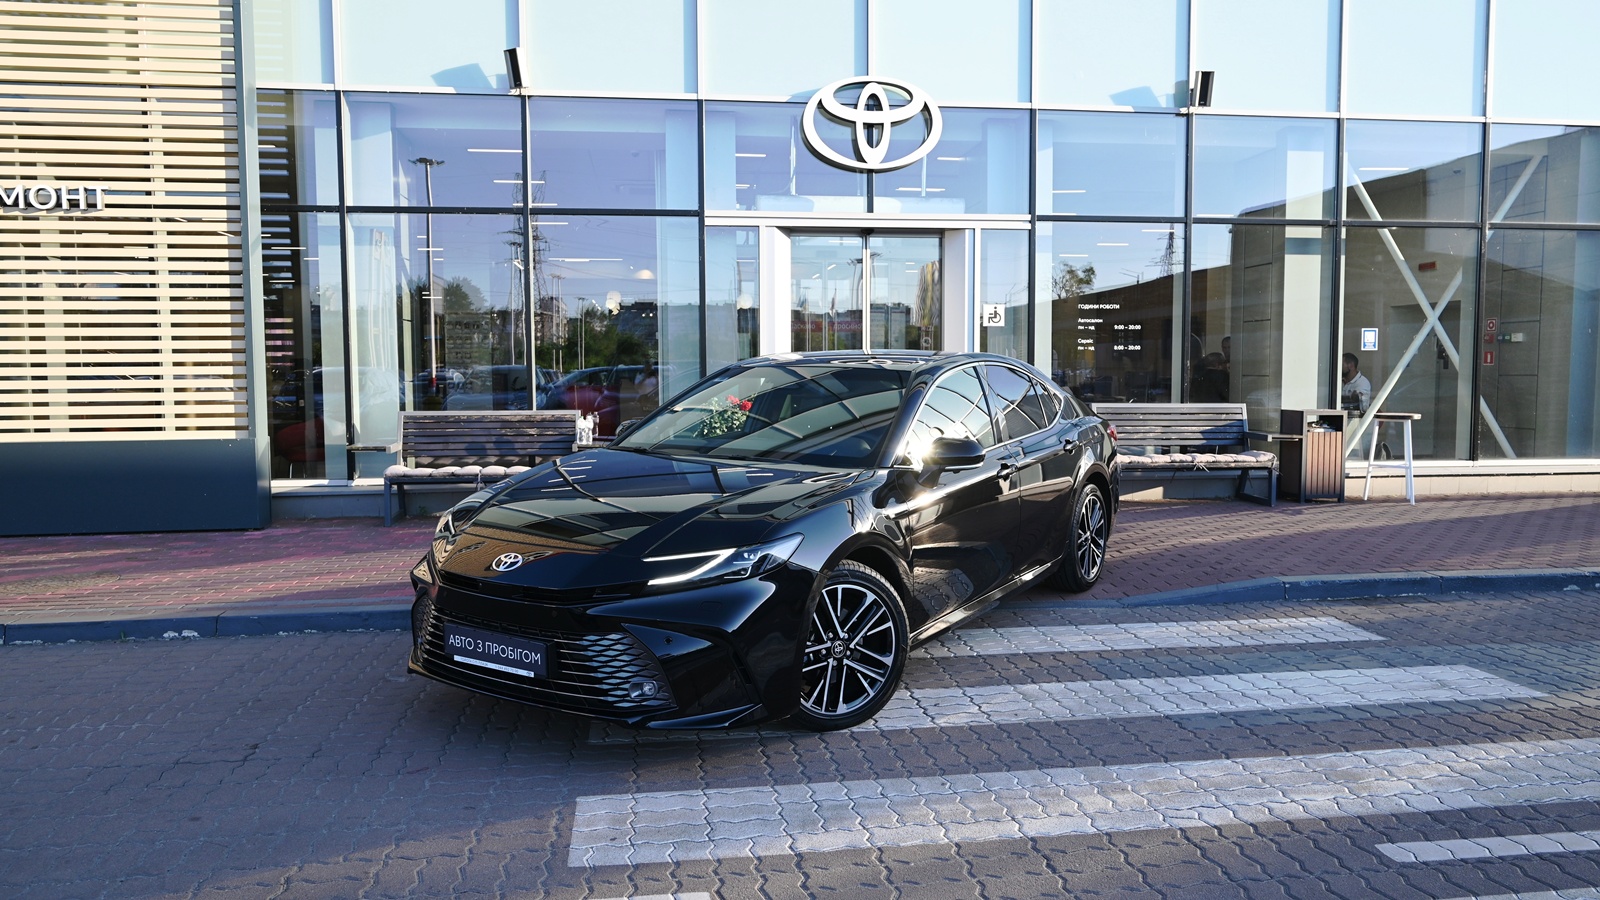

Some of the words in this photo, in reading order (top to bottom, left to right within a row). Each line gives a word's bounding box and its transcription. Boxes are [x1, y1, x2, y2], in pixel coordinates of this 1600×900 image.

[448, 634, 474, 650] АВТО
[476, 640, 483, 652] З
[485, 642, 541, 665] ПРОБІГОМ
